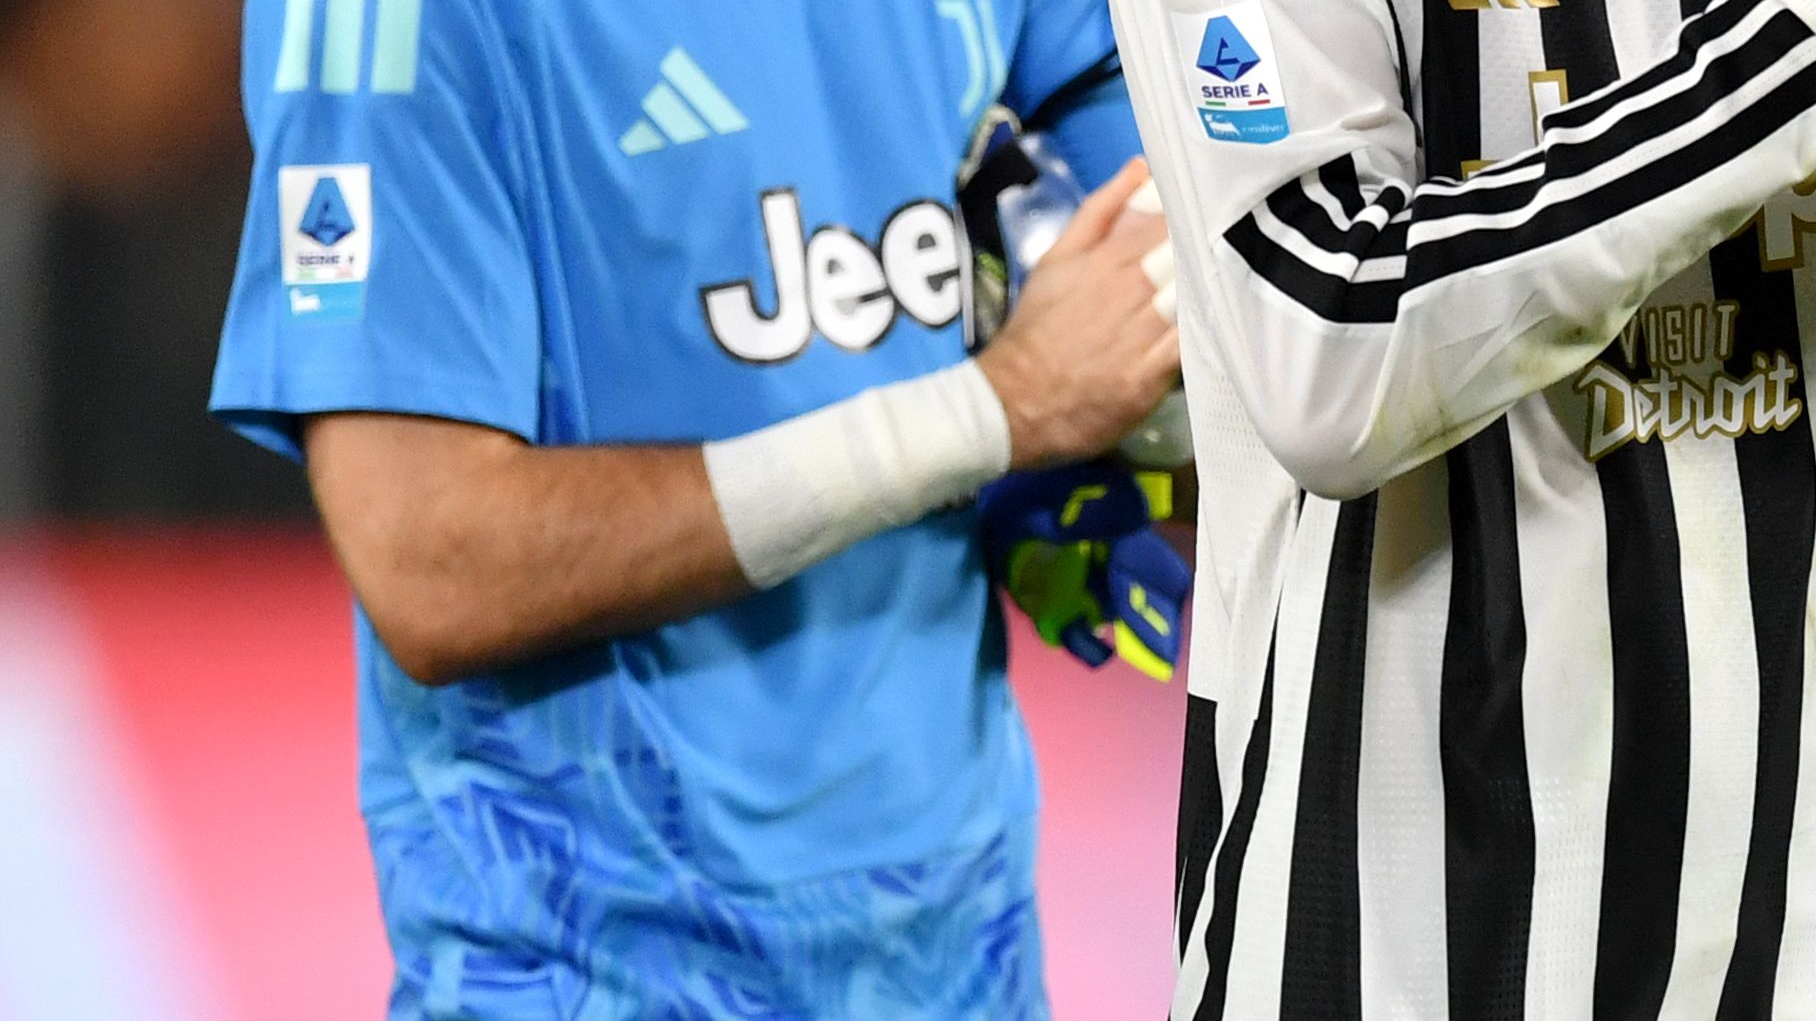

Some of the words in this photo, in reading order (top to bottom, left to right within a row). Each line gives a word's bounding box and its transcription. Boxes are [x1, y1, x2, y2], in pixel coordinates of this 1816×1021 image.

[1201, 84, 1252, 99] SERIE
[1256, 82, 1269, 97] A
[699, 185, 963, 364] Jee
[1618, 299, 1741, 370] VISIT
[1573, 358, 1803, 463] Detroit
